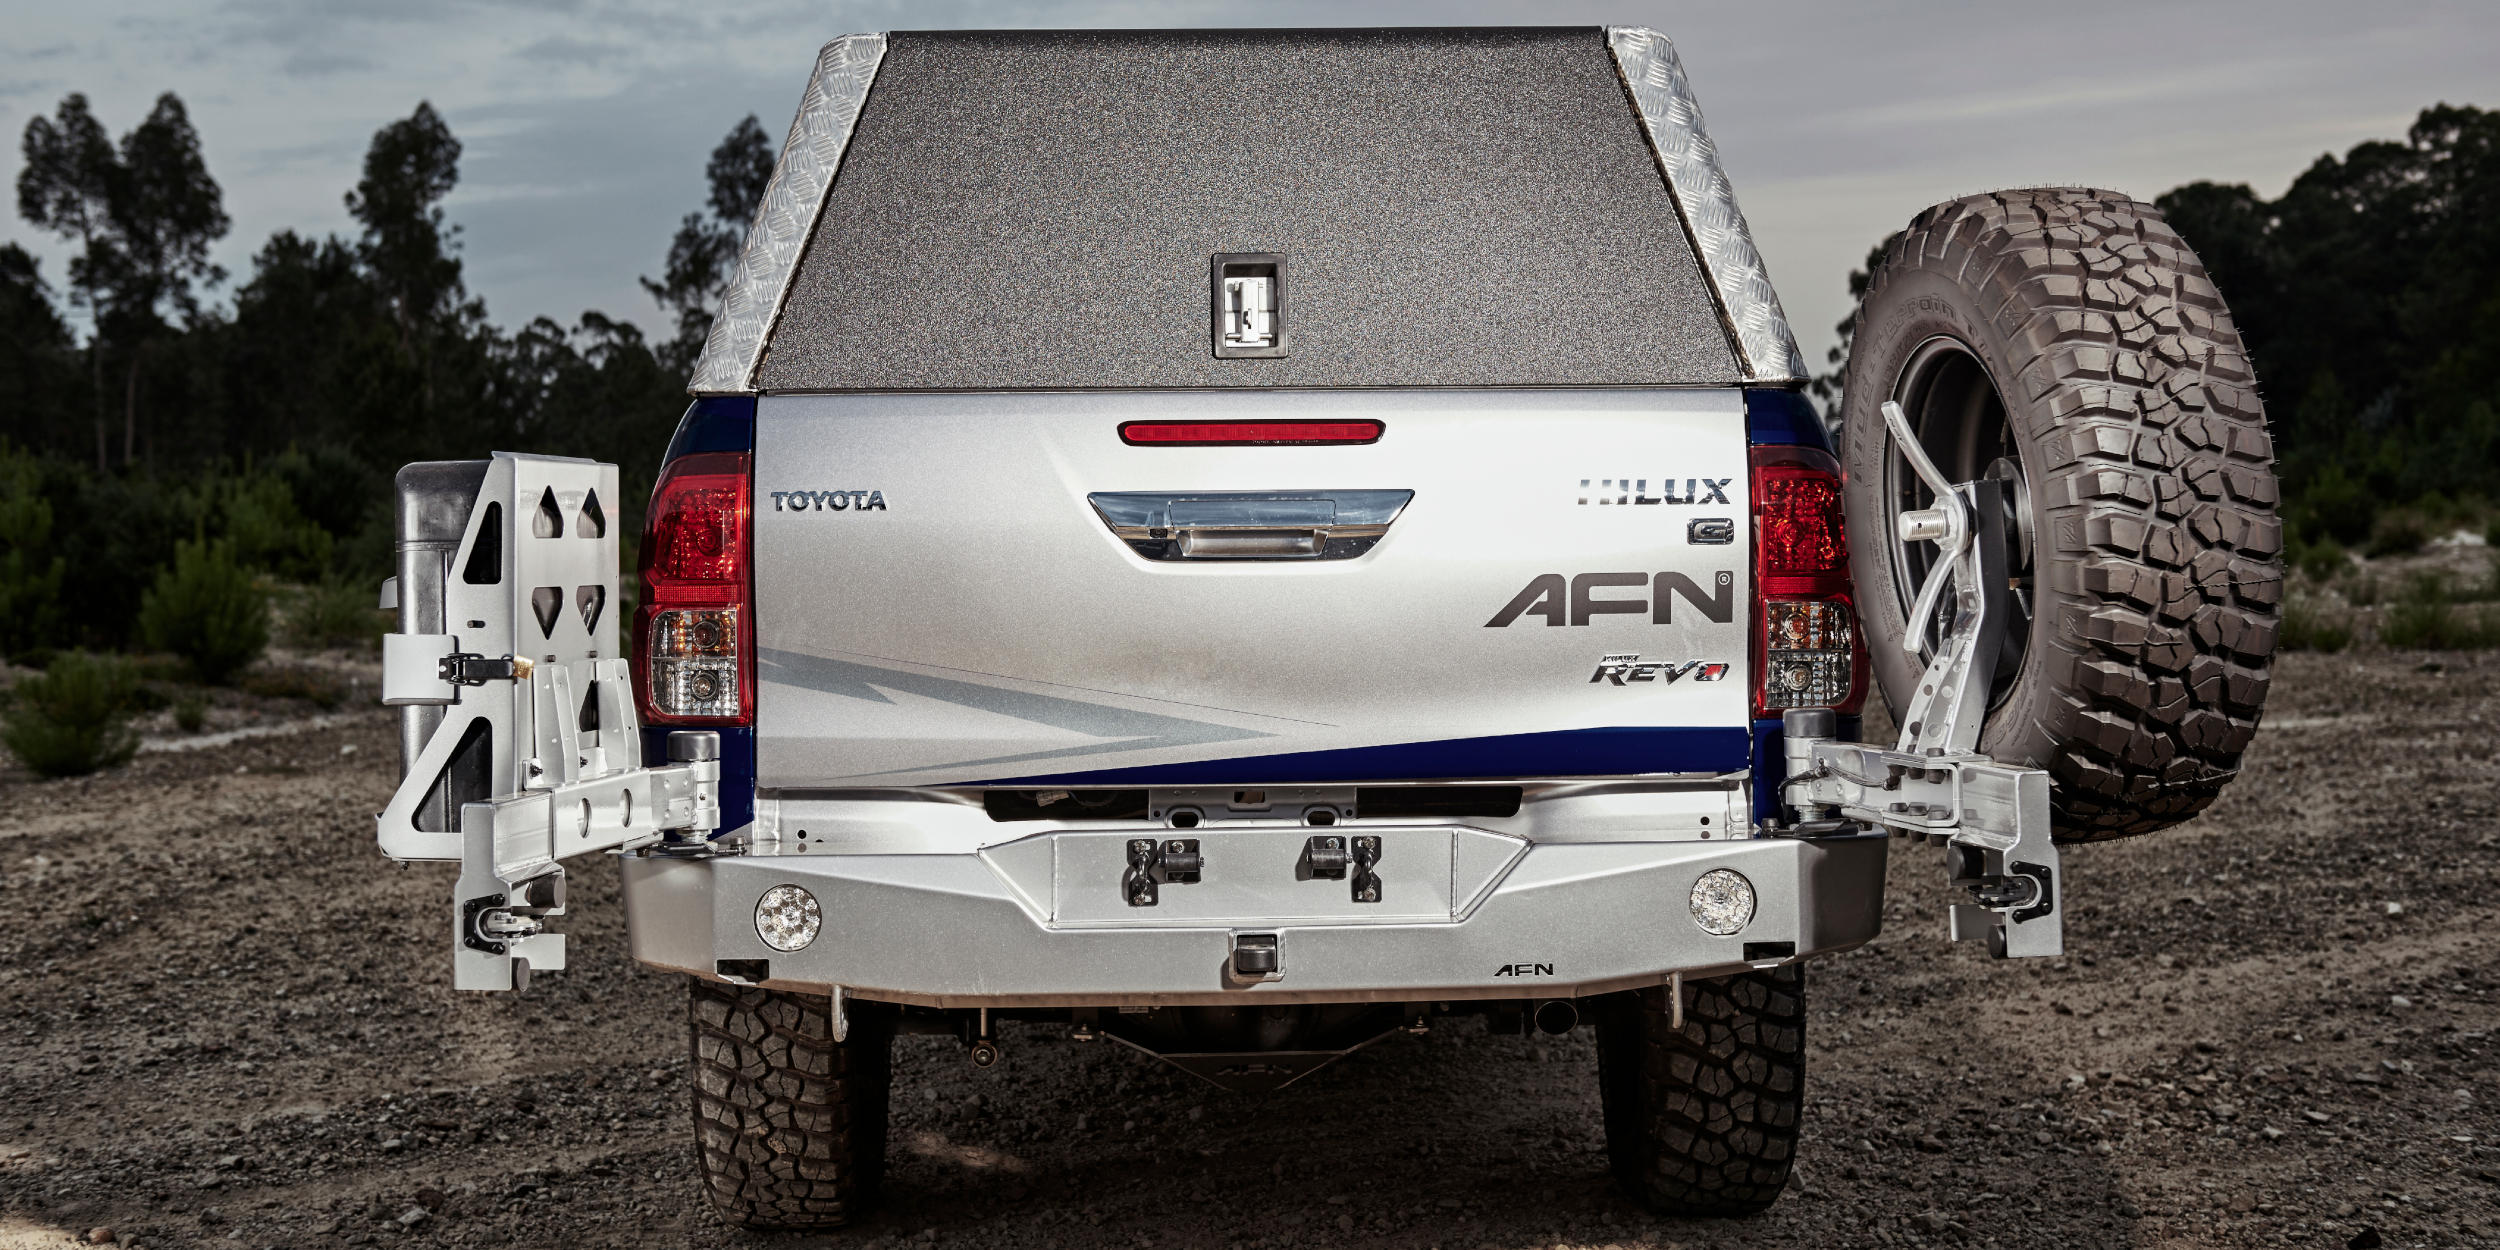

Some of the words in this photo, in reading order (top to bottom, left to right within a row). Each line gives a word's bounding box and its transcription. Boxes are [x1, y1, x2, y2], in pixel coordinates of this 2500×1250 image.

[770, 490, 888, 512] TOYOTA
[1590, 659, 1730, 687] REVO
[1493, 963, 1554, 977] AFN
